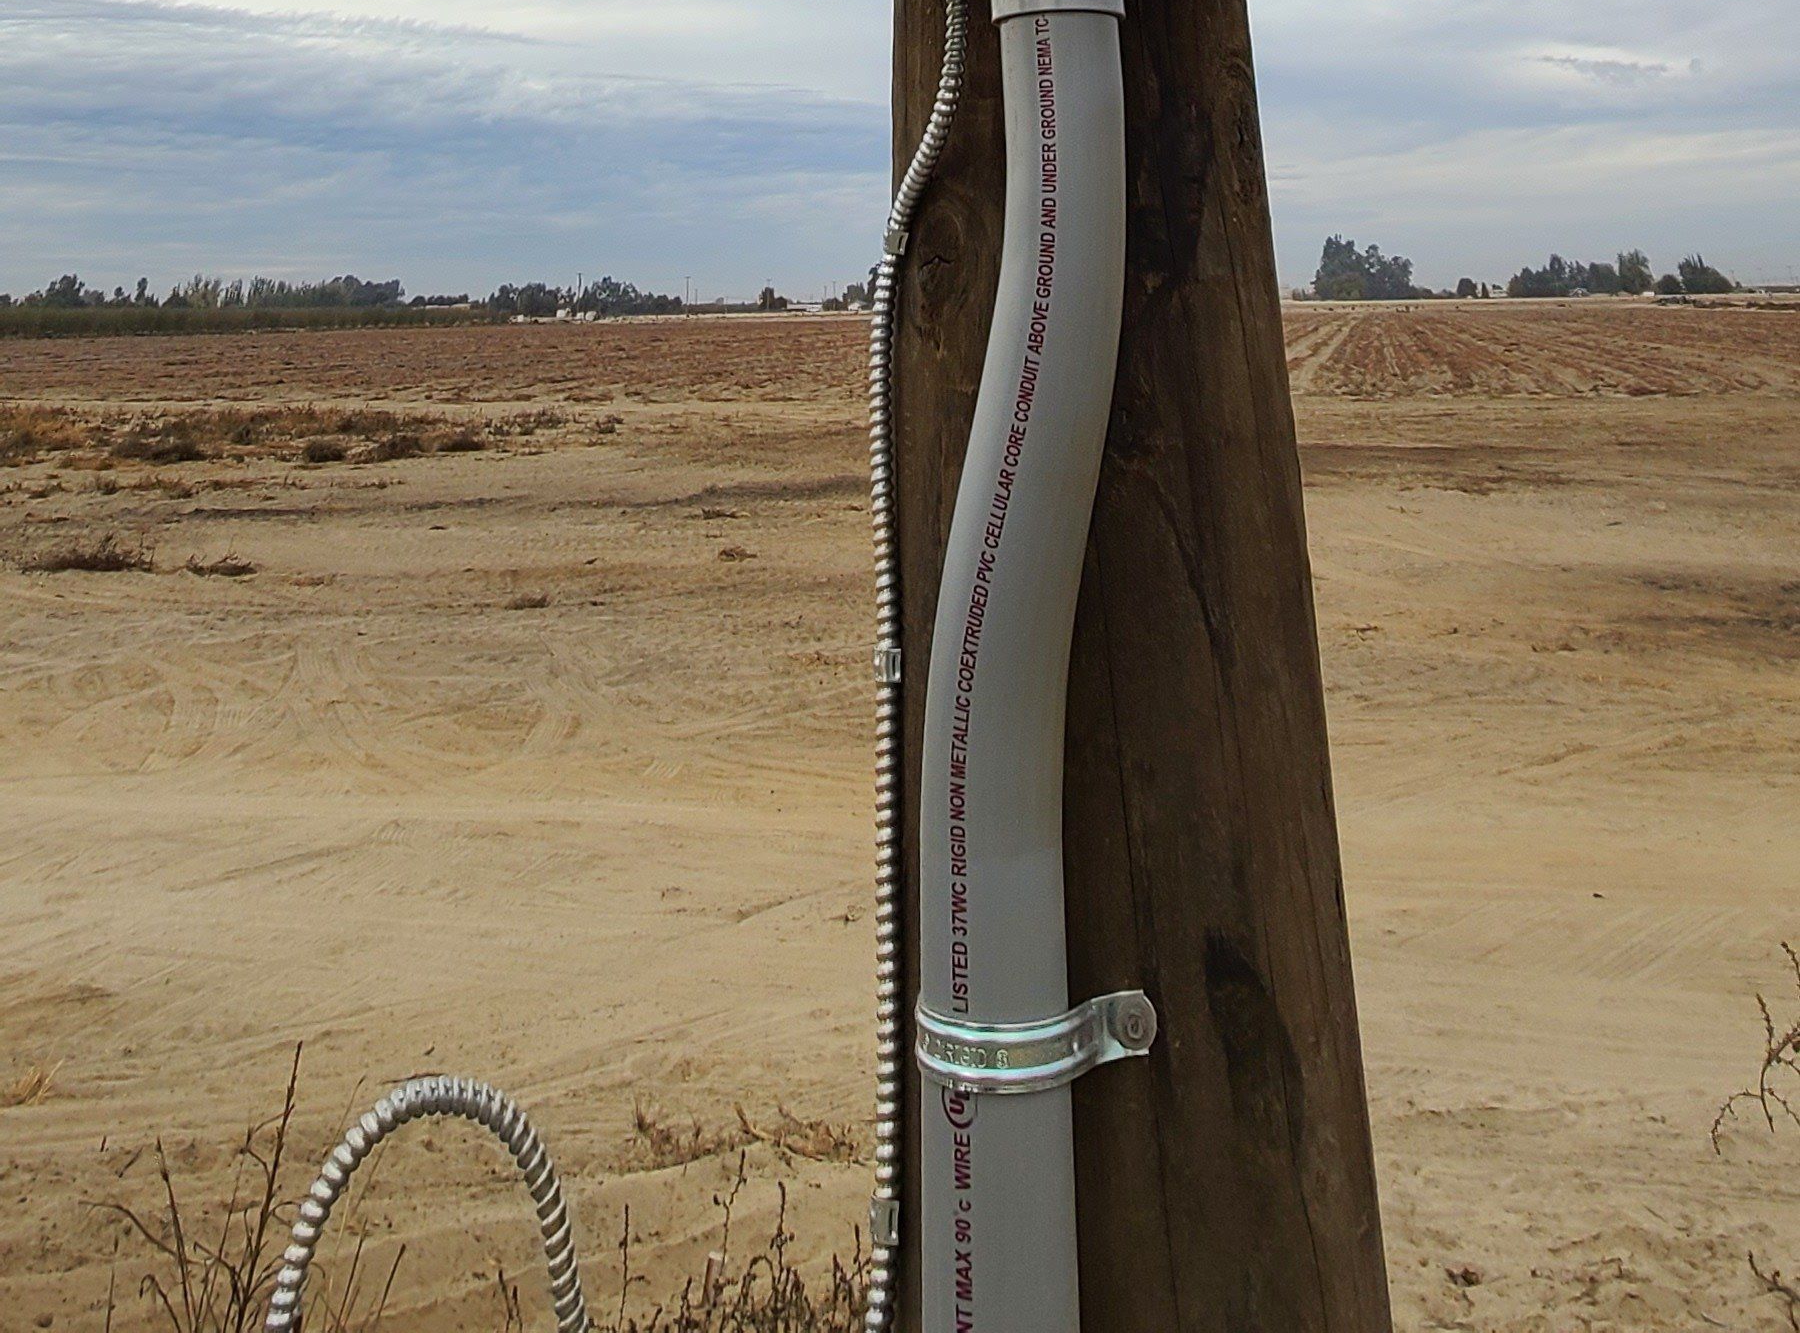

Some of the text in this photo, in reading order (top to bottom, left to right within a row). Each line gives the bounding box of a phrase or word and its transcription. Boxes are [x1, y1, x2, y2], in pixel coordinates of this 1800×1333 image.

[1036, 38, 1053, 76] NEMA
[1039, 79, 1056, 140] GROUND
[1042, 143, 1057, 193] UNDER
[1041, 197, 1056, 229] AND
[1036, 232, 1055, 299] GROUND
[1027, 301, 1049, 356] ABOVE
[1014, 355, 1040, 423] CONDUIT
[1003, 423, 1027, 467] CORE
[984, 469, 1016, 549] CELLULAR
[976, 551, 996, 584] PVC
[957, 585, 989, 693] COEXTRUDED
[951, 695, 971, 779] METALLIC
[949, 782, 965, 821] NON
[950, 825, 967, 877] RIGID
[951, 882, 968, 936] 37WC
[952, 941, 969, 1014] LISTED
[953, 1132, 971, 1190] WIRE
[955, 1249, 973, 1301] MAX
